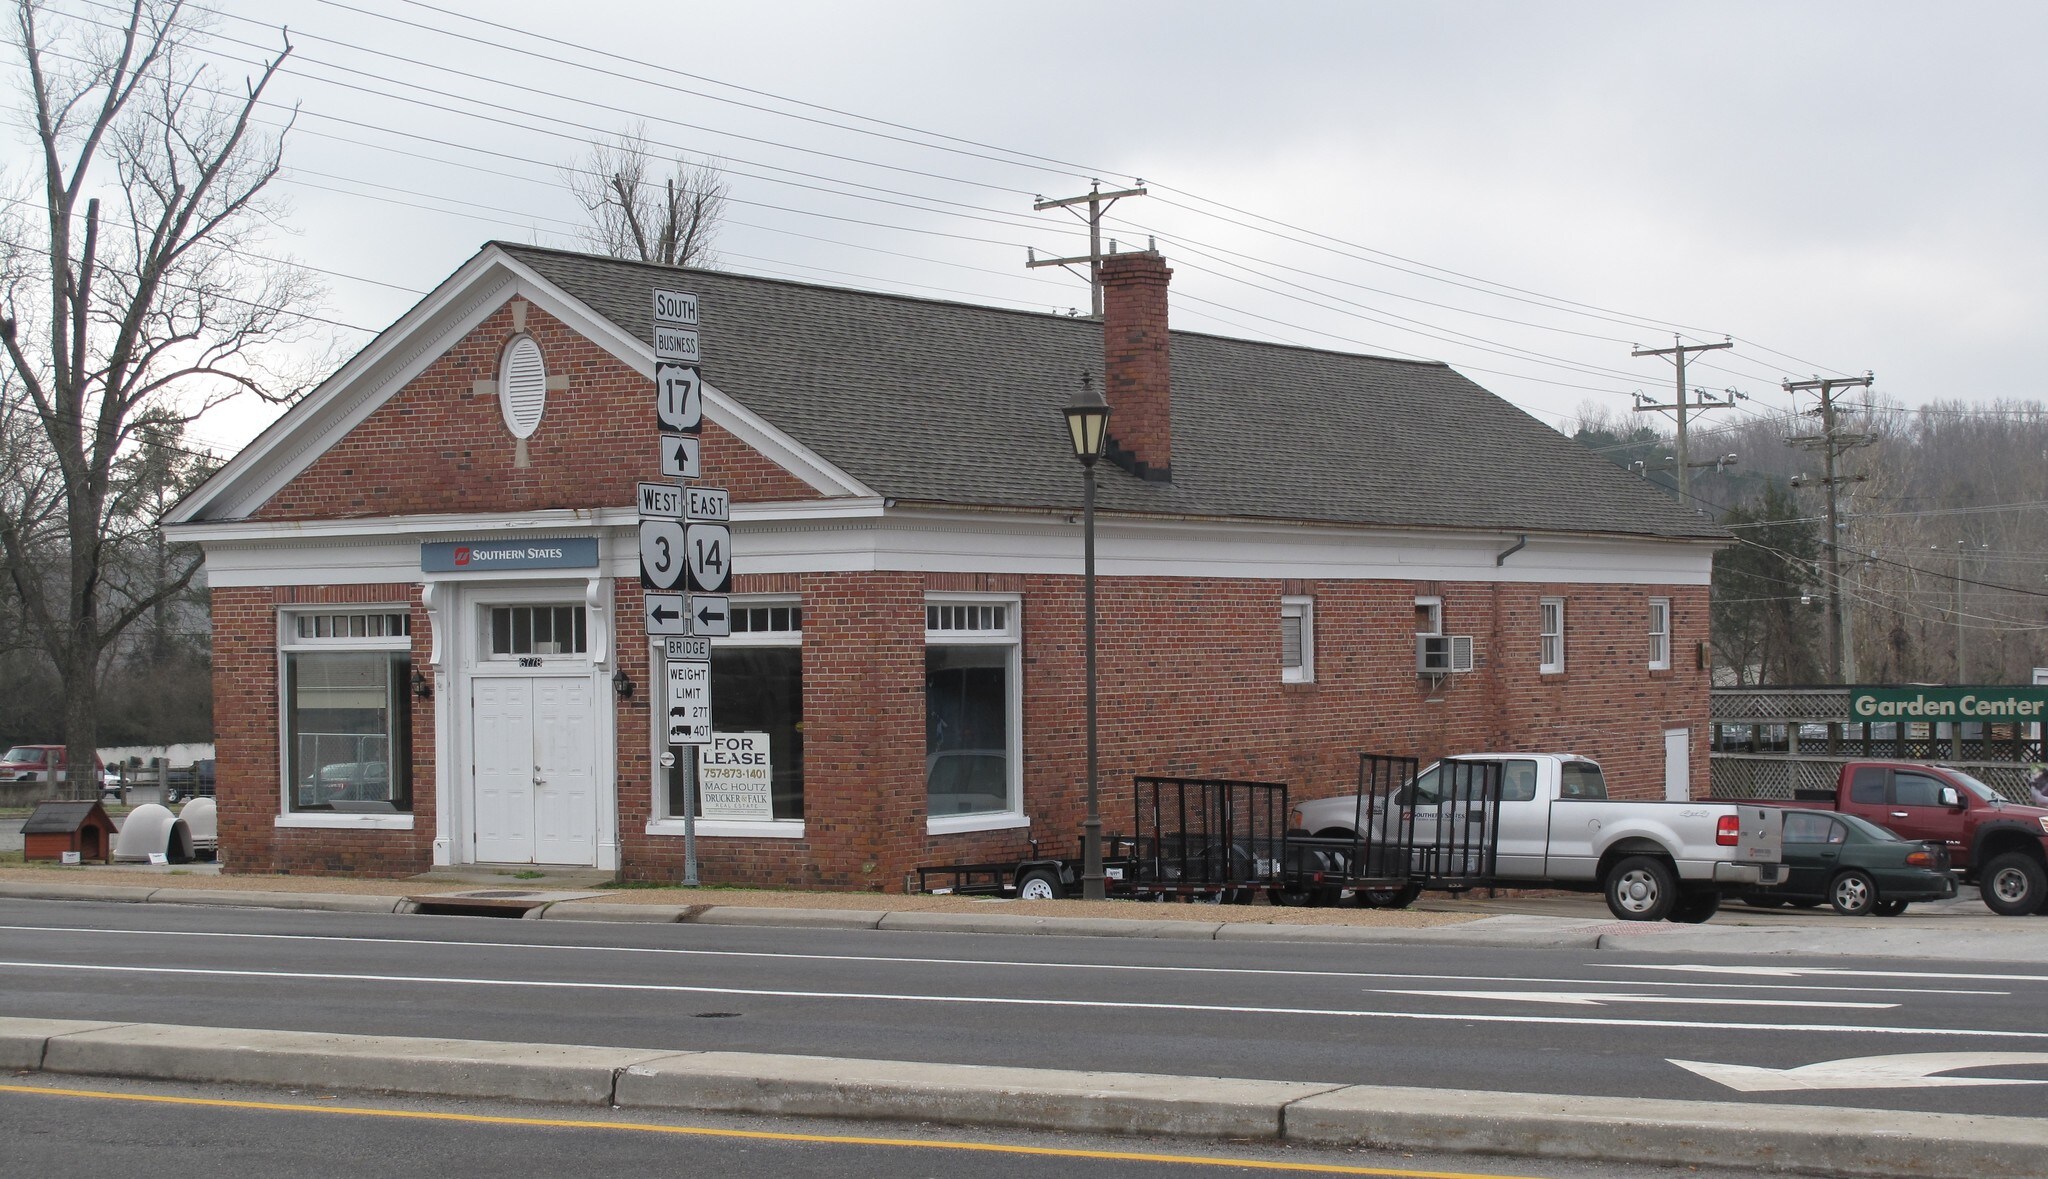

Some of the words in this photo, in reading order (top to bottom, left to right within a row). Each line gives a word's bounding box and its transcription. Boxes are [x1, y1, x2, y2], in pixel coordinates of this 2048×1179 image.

[657, 294, 696, 320] SOUTH
[658, 334, 696, 354] BUSINESS
[666, 378, 692, 415] 17
[643, 488, 677, 512] WEST
[691, 493, 723, 515] EAST
[472, 549, 525, 561] SOUTHERN
[527, 547, 563, 559] STATES
[655, 536, 671, 573] 3
[696, 538, 722, 575] 14
[669, 641, 705, 654] BRIDGE
[670, 668, 706, 680] WEIGHT
[676, 687, 701, 699] LIMIT
[1855, 694, 1956, 716] Garden
[1958, 694, 2044, 716] Center
[692, 706, 708, 718] 27T
[693, 725, 709, 737] 40T
[715, 738, 753, 750] FOR
[703, 752, 766, 765] LEASE
[704, 782, 728, 791] MAC
[730, 783, 767, 792] HOUTZ
[705, 793, 741, 803] DRUCKER
[748, 794, 767, 803] FALK
